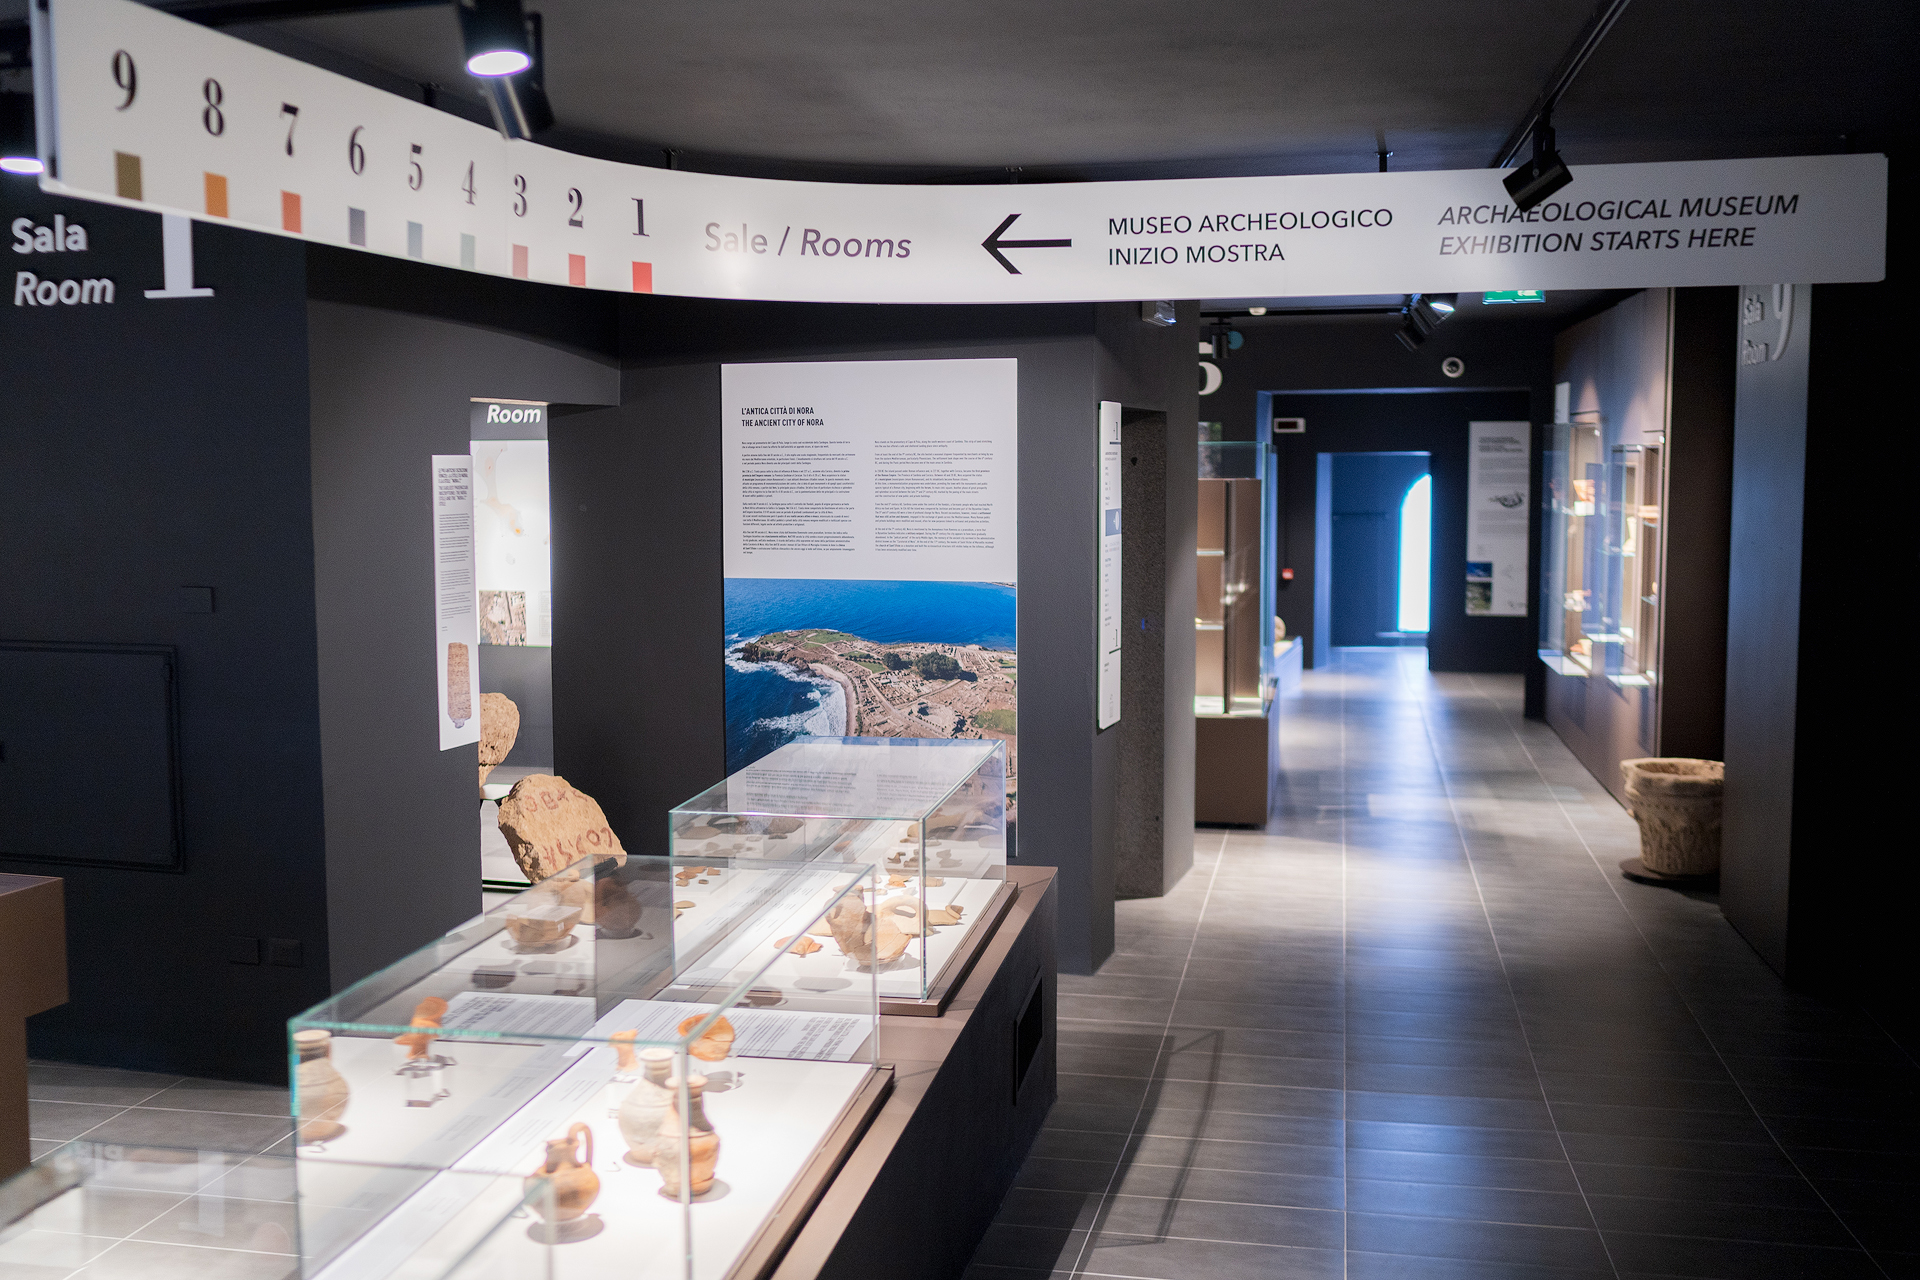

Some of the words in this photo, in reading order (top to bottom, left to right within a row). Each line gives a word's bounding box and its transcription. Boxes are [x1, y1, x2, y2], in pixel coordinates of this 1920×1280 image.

[112, 50, 137, 110] 9
[202, 78, 226, 137] 8
[281, 102, 300, 156] 7
[348, 126, 366, 176] 6
[408, 143, 424, 191] 5
[461, 160, 477, 205] 4
[513, 174, 528, 217] 3
[567, 187, 584, 228] 2
[631, 197, 650, 237] 1
[1109, 215, 1192, 235] MUSEO
[1198, 208, 1393, 233] ARCHEOLOGICO
[1437, 198, 1672, 225] ARCHAEOLOGICAL
[1679, 194, 1800, 218] MUSEUM
[11, 213, 88, 254] Sala
[704, 222, 768, 256] Sale
[800, 228, 912, 259] Rooms
[1439, 232, 1583, 256] EXHIBITION
[1589, 229, 1681, 252] STARTS
[1687, 226, 1756, 248] HERE
[1109, 246, 1179, 266] INIZIO
[1186, 243, 1285, 264] MOSTRA
[14, 271, 115, 306] Room
[486, 404, 541, 424] Room
[742, 419, 753, 427] THE
[755, 419, 781, 427] ANCIENT
[807, 418, 824, 426] NORA
[770, 406, 788, 415] CITTÀ
[789, 407, 796, 415] DI
[797, 407, 815, 415] NORA
